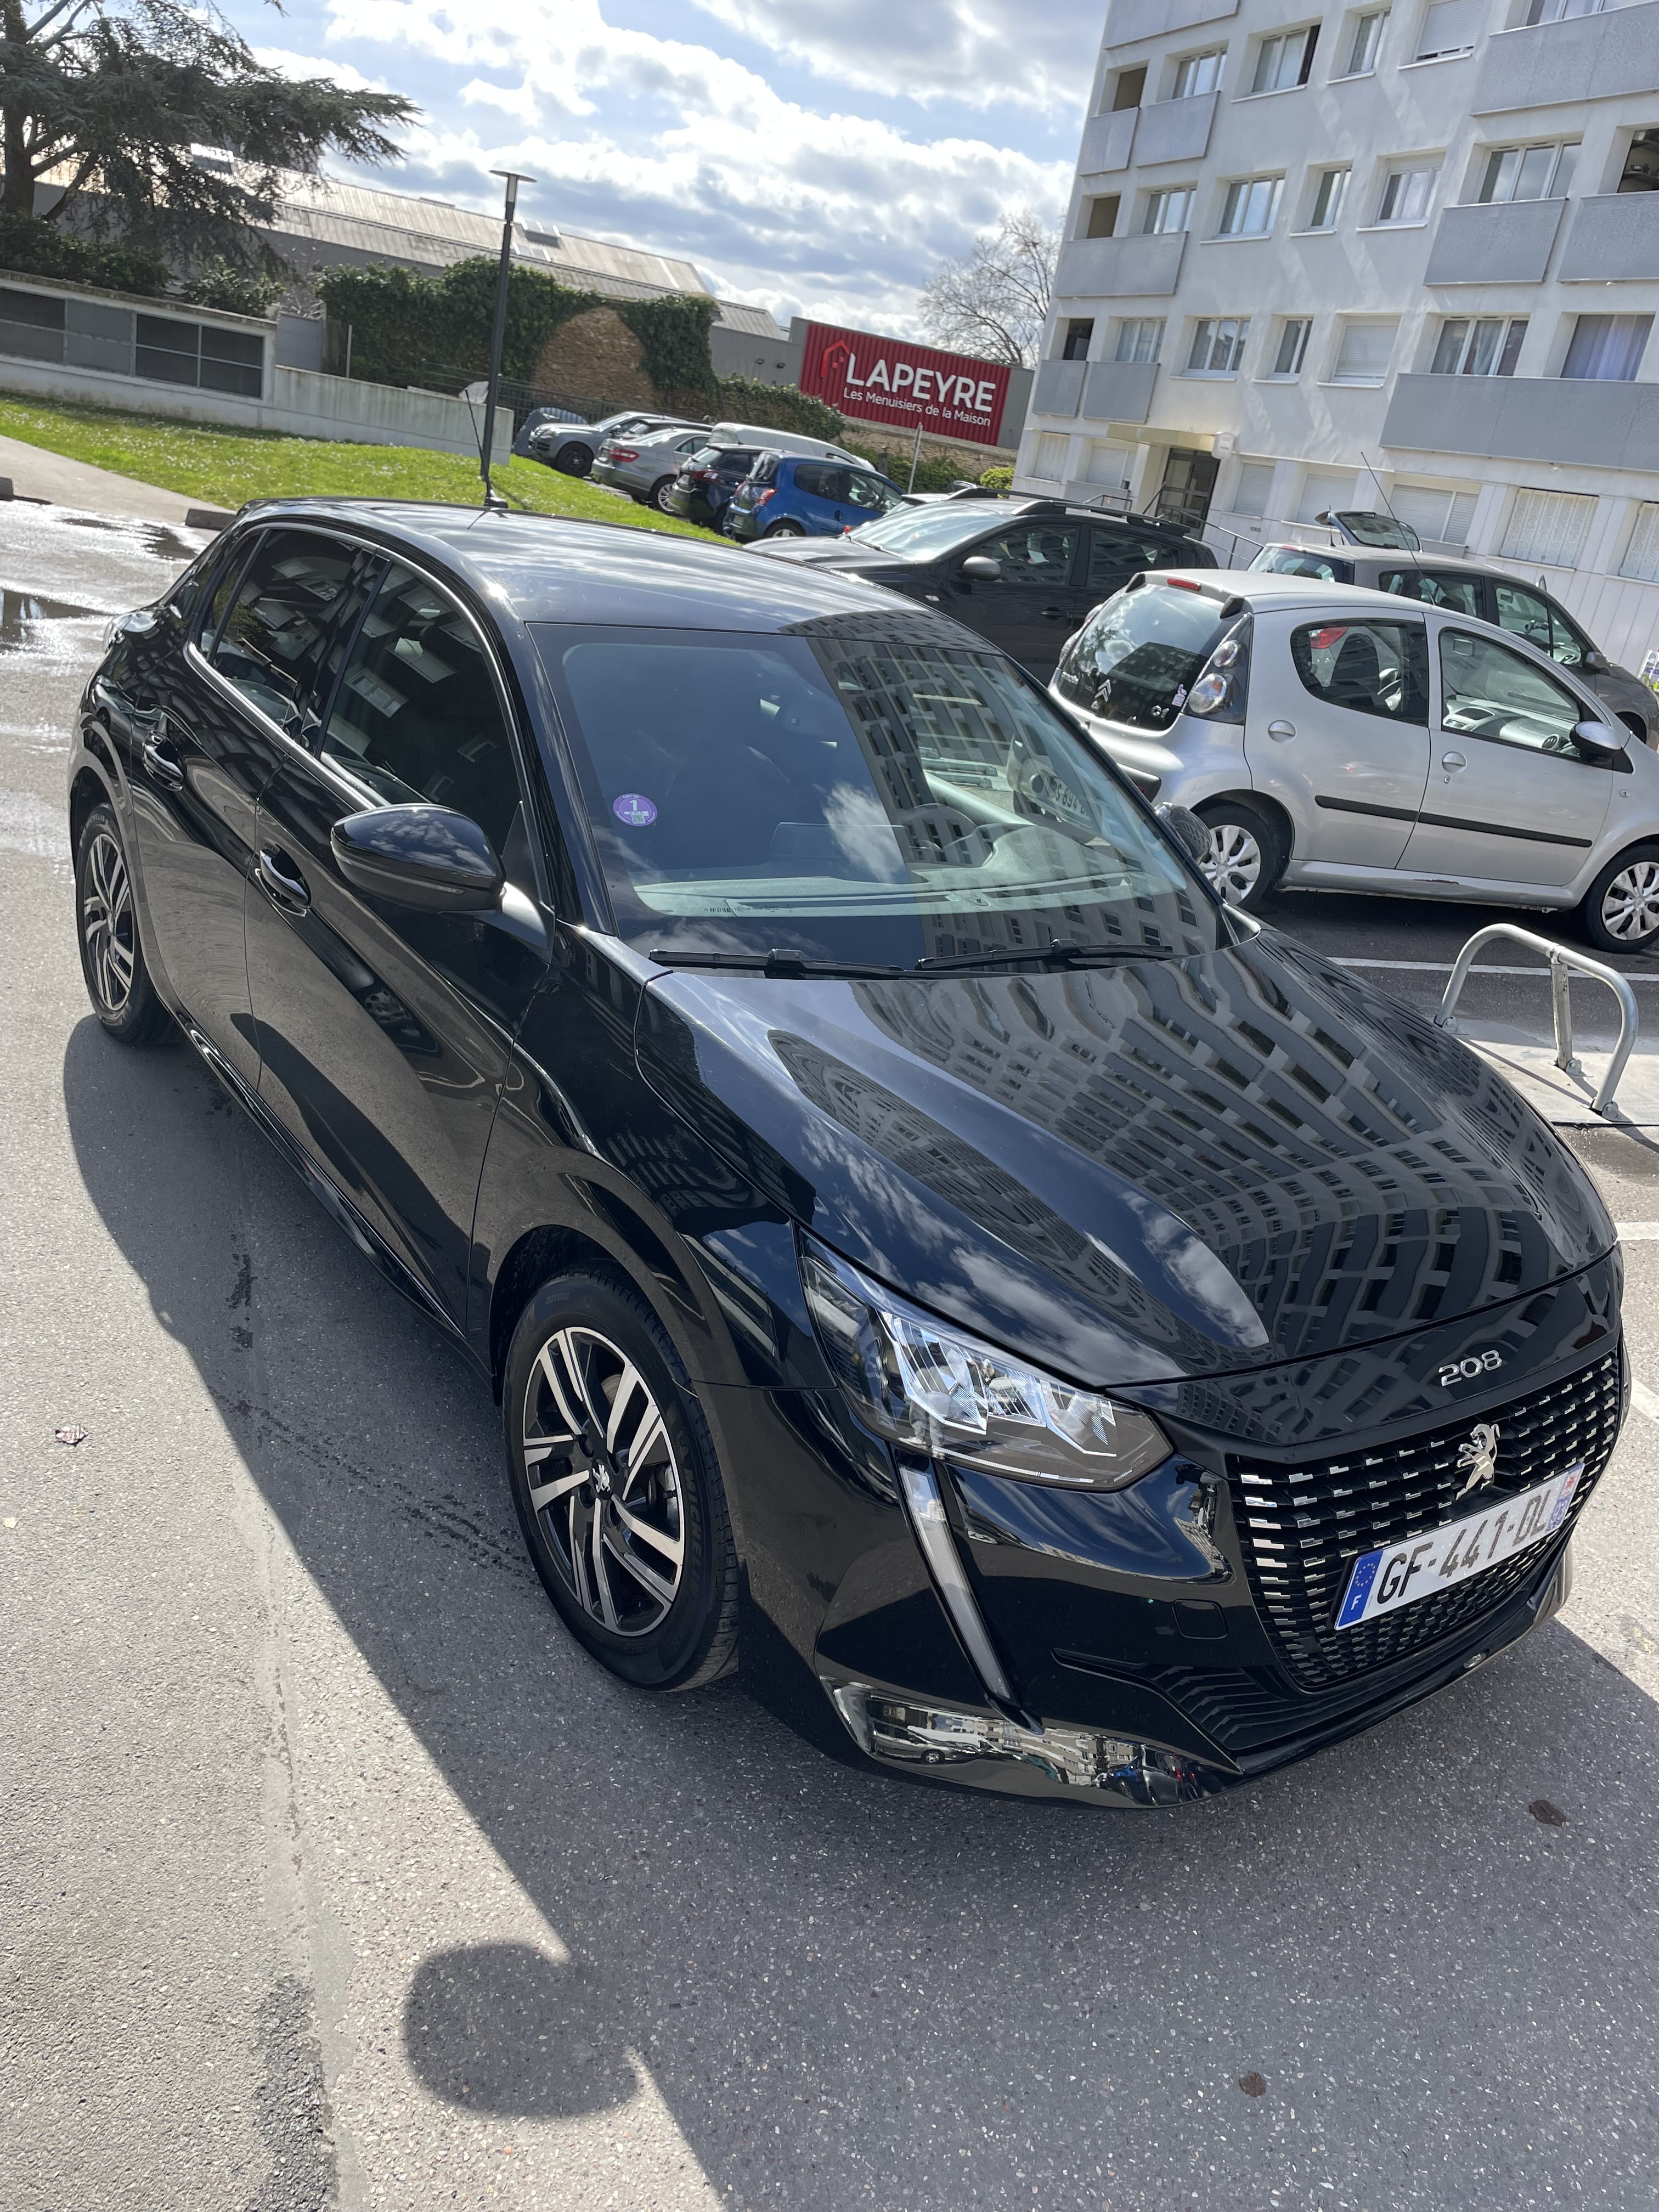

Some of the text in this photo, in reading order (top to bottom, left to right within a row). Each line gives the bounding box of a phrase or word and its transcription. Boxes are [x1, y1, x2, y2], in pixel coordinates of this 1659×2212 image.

[846, 352, 996, 413] LAPEYRE
[843, 387, 990, 426] Les Menuisiers de la Maison
[630, 799, 637, 810] 1
[546, 1292, 571, 1305] OUTSIDE
[1438, 1350, 1502, 1387] 208
[1377, 1488, 1551, 1605] GF-441-DL
[1351, 1594, 1362, 1611] F
